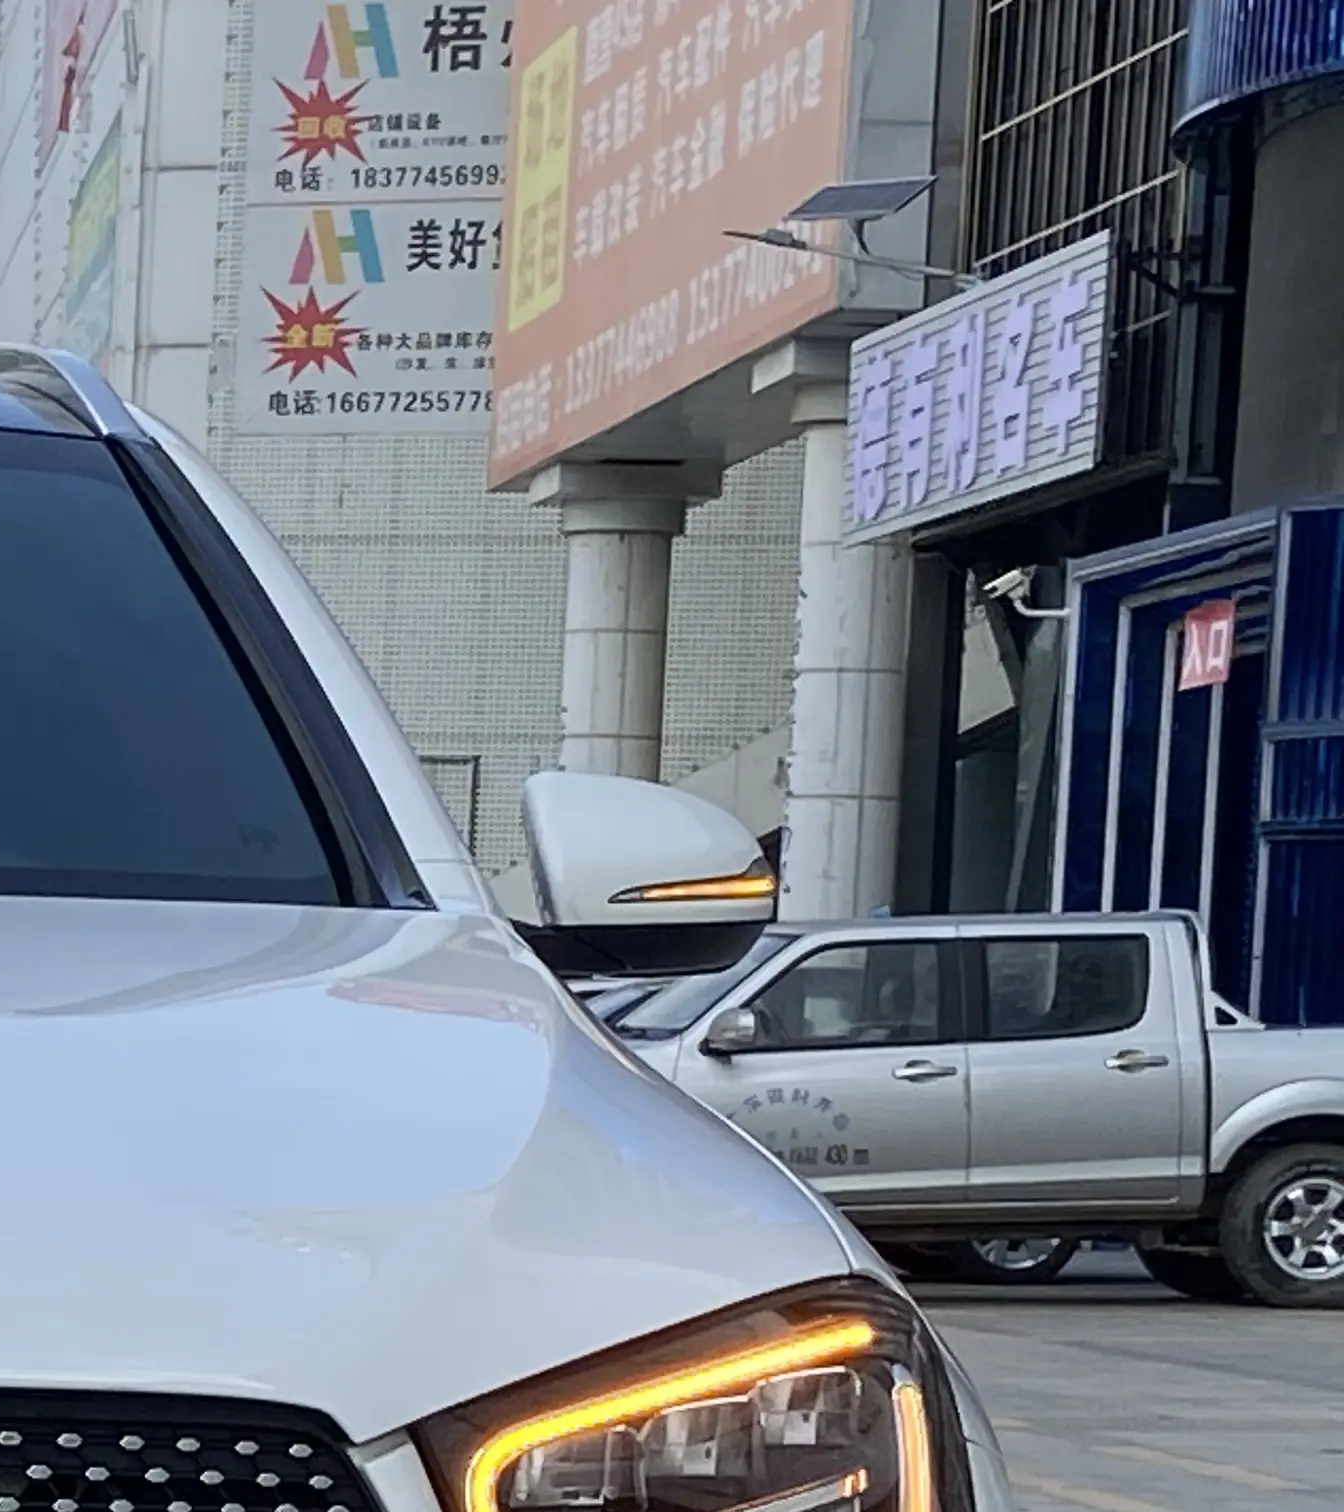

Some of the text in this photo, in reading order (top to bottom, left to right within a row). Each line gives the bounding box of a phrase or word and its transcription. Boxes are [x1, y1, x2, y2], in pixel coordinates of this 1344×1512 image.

[285, 323, 336, 348] 全新
[357, 330, 493, 351] 各种大品牌库存
[1181, 619, 1228, 677] 入口
